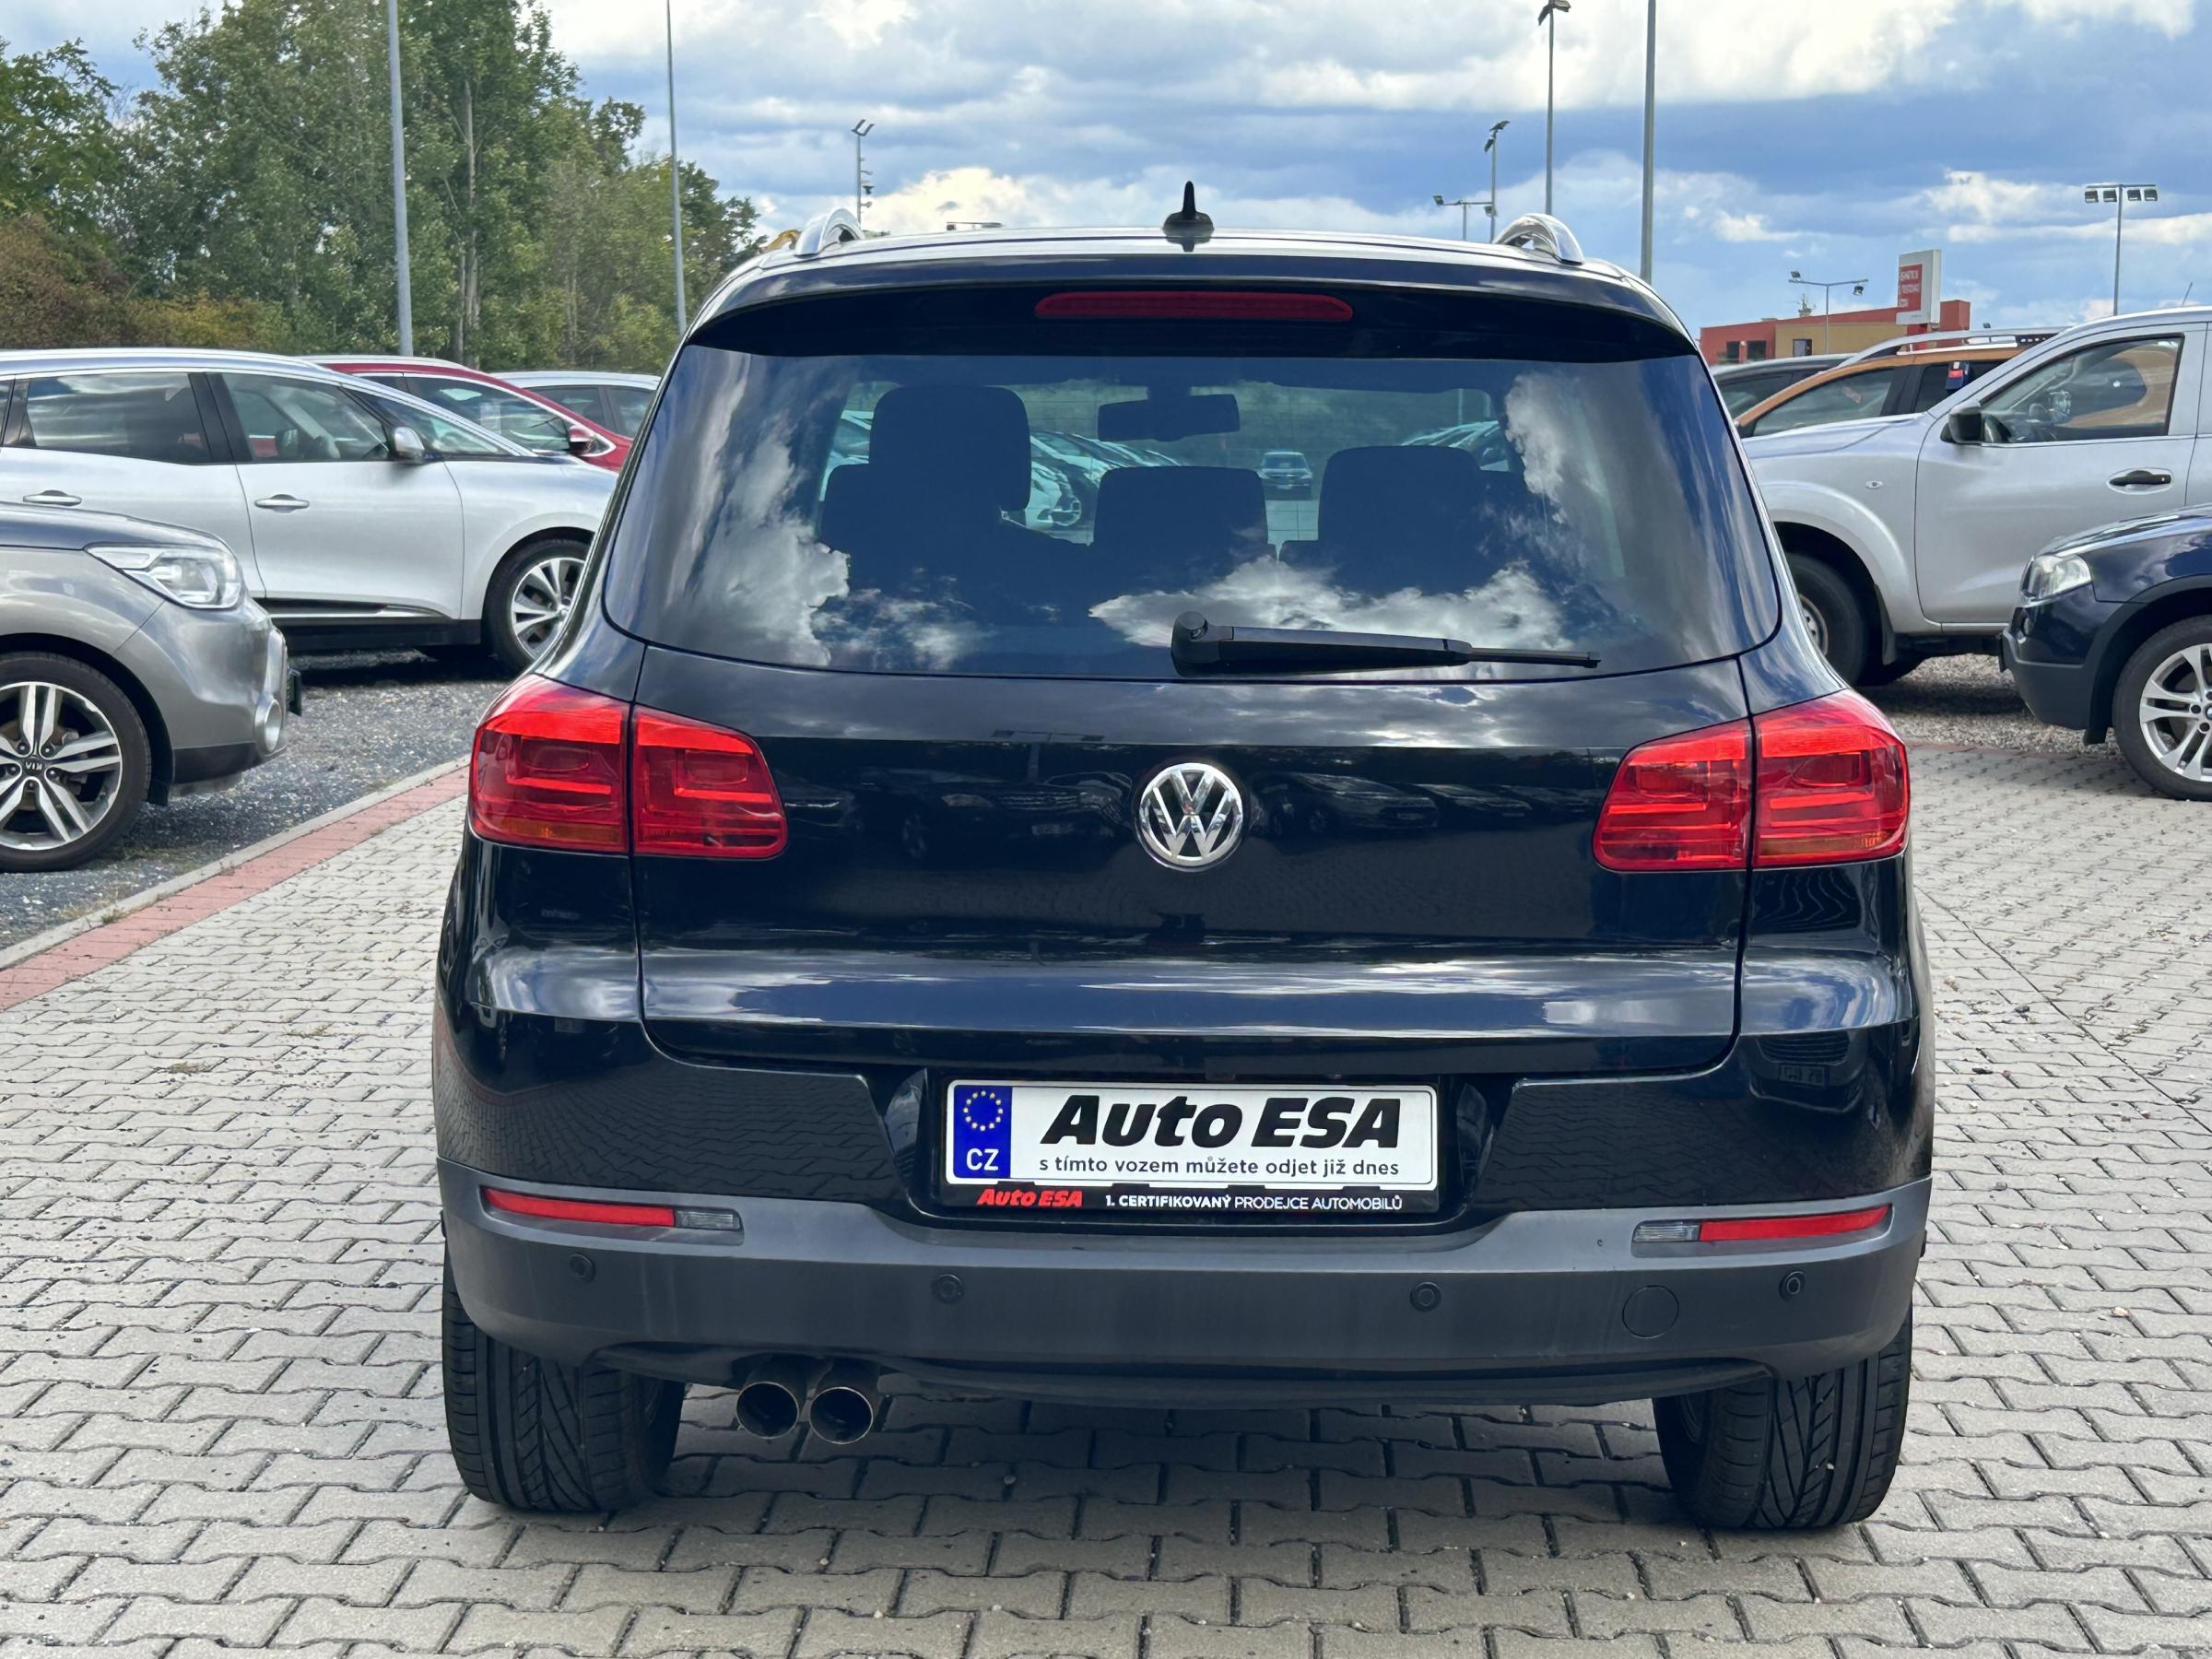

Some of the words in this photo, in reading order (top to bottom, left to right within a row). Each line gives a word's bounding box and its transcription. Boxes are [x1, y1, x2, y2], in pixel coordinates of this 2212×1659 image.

[1040, 1094, 1243, 1148] Auto
[1251, 1097, 1401, 1148] ESA
[966, 1148, 999, 1171] CZ
[1039, 1159, 1049, 1171] s
[1055, 1155, 1107, 1171] tímto
[1114, 1159, 1179, 1173] vozem
[1186, 1156, 1259, 1174] můžete
[1265, 1159, 1317, 1177] odjet
[1323, 1158, 1347, 1178] již
[1352, 1159, 1399, 1175] dnes
[977, 1188, 1037, 1206] Auto
[1038, 1190, 1083, 1207] ESA
[1106, 1194, 1116, 1206] 1.
[1118, 1194, 1232, 1208] CERTIFIKOVANÝ
[1234, 1196, 1309, 1209] PRODEJCE
[1311, 1194, 1403, 1210] AUTOMOBILŮ
